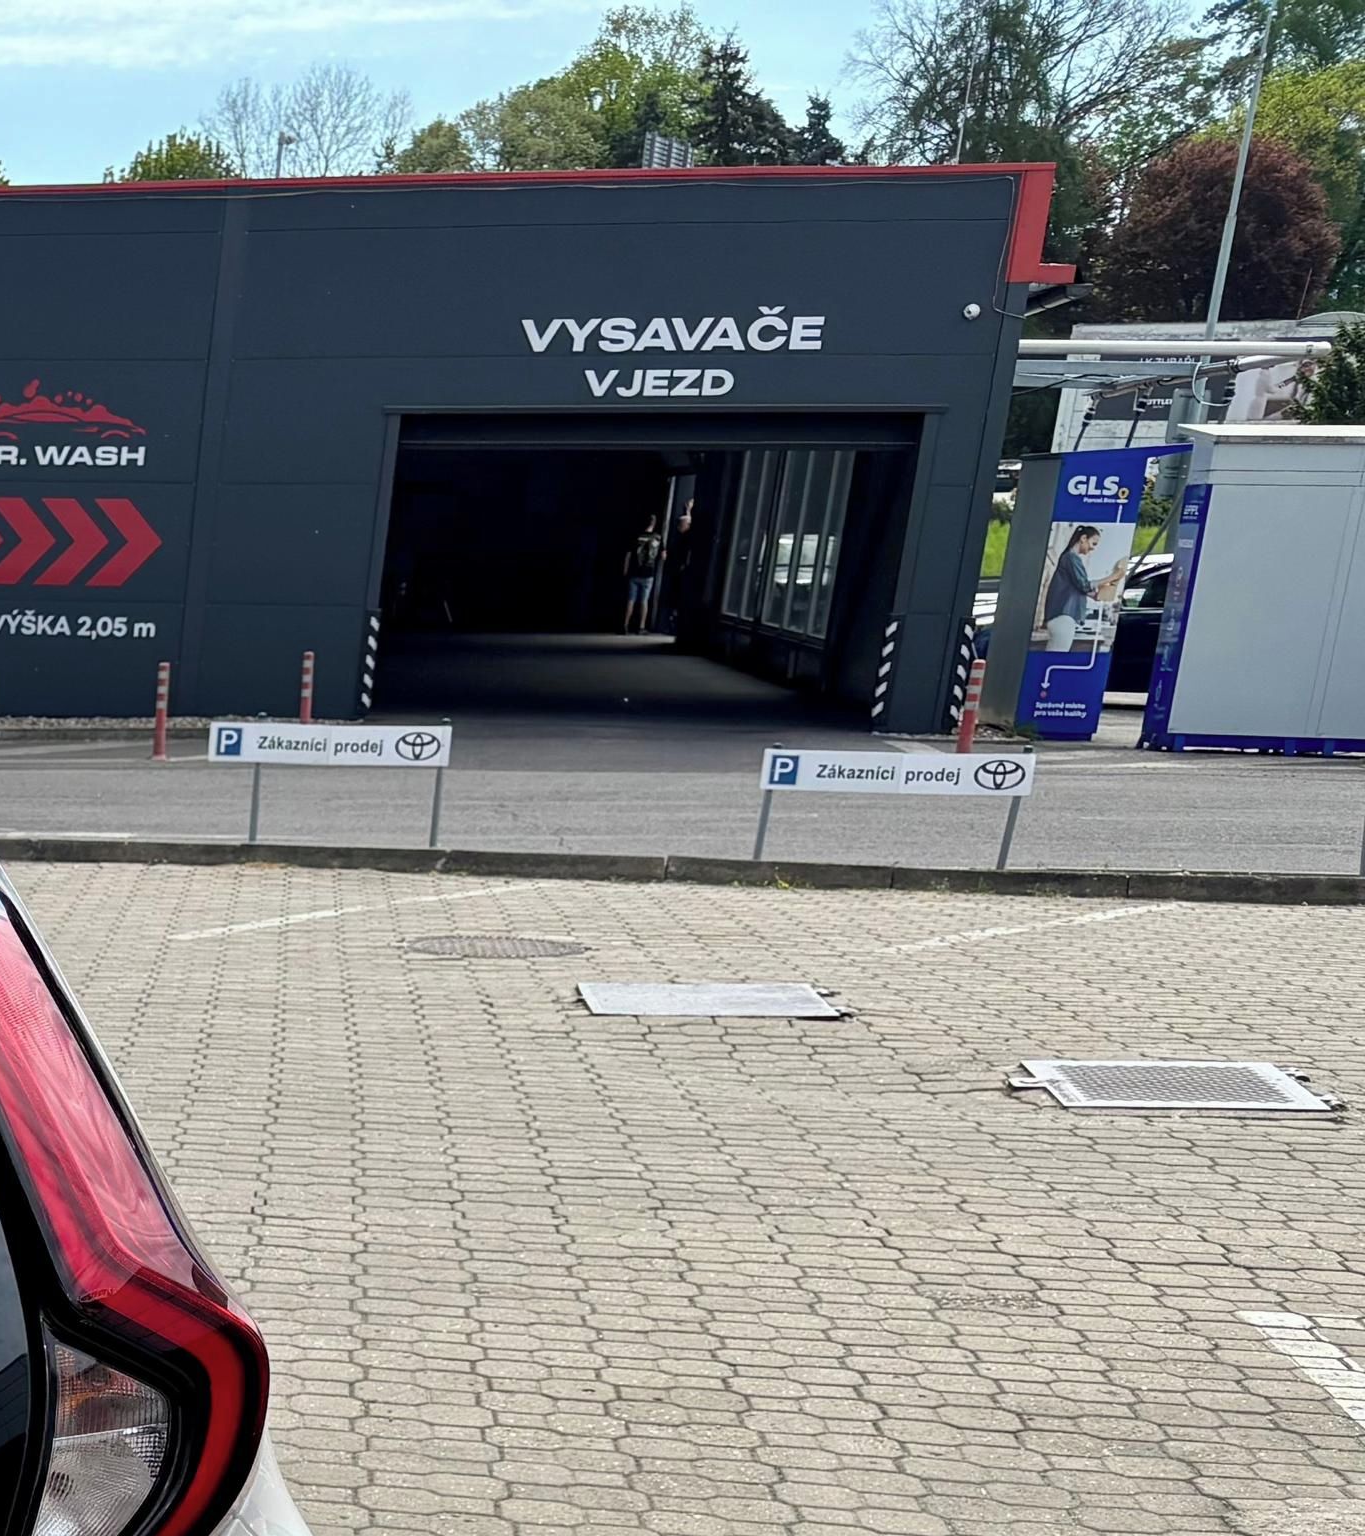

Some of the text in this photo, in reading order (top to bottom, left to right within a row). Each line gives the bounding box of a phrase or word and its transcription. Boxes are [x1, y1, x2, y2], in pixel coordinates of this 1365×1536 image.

[521, 305, 825, 353] VYSAVAČE
[584, 368, 735, 397] VJEZD
[34, 445, 146, 467] WASH
[1067, 475, 1120, 496] GLS
[76, 616, 128, 640] 2,05
[133, 621, 156, 638] m
[220, 730, 384, 756] P Zákazníci prodej
[773, 758, 962, 785] P Zákazníci prodej
